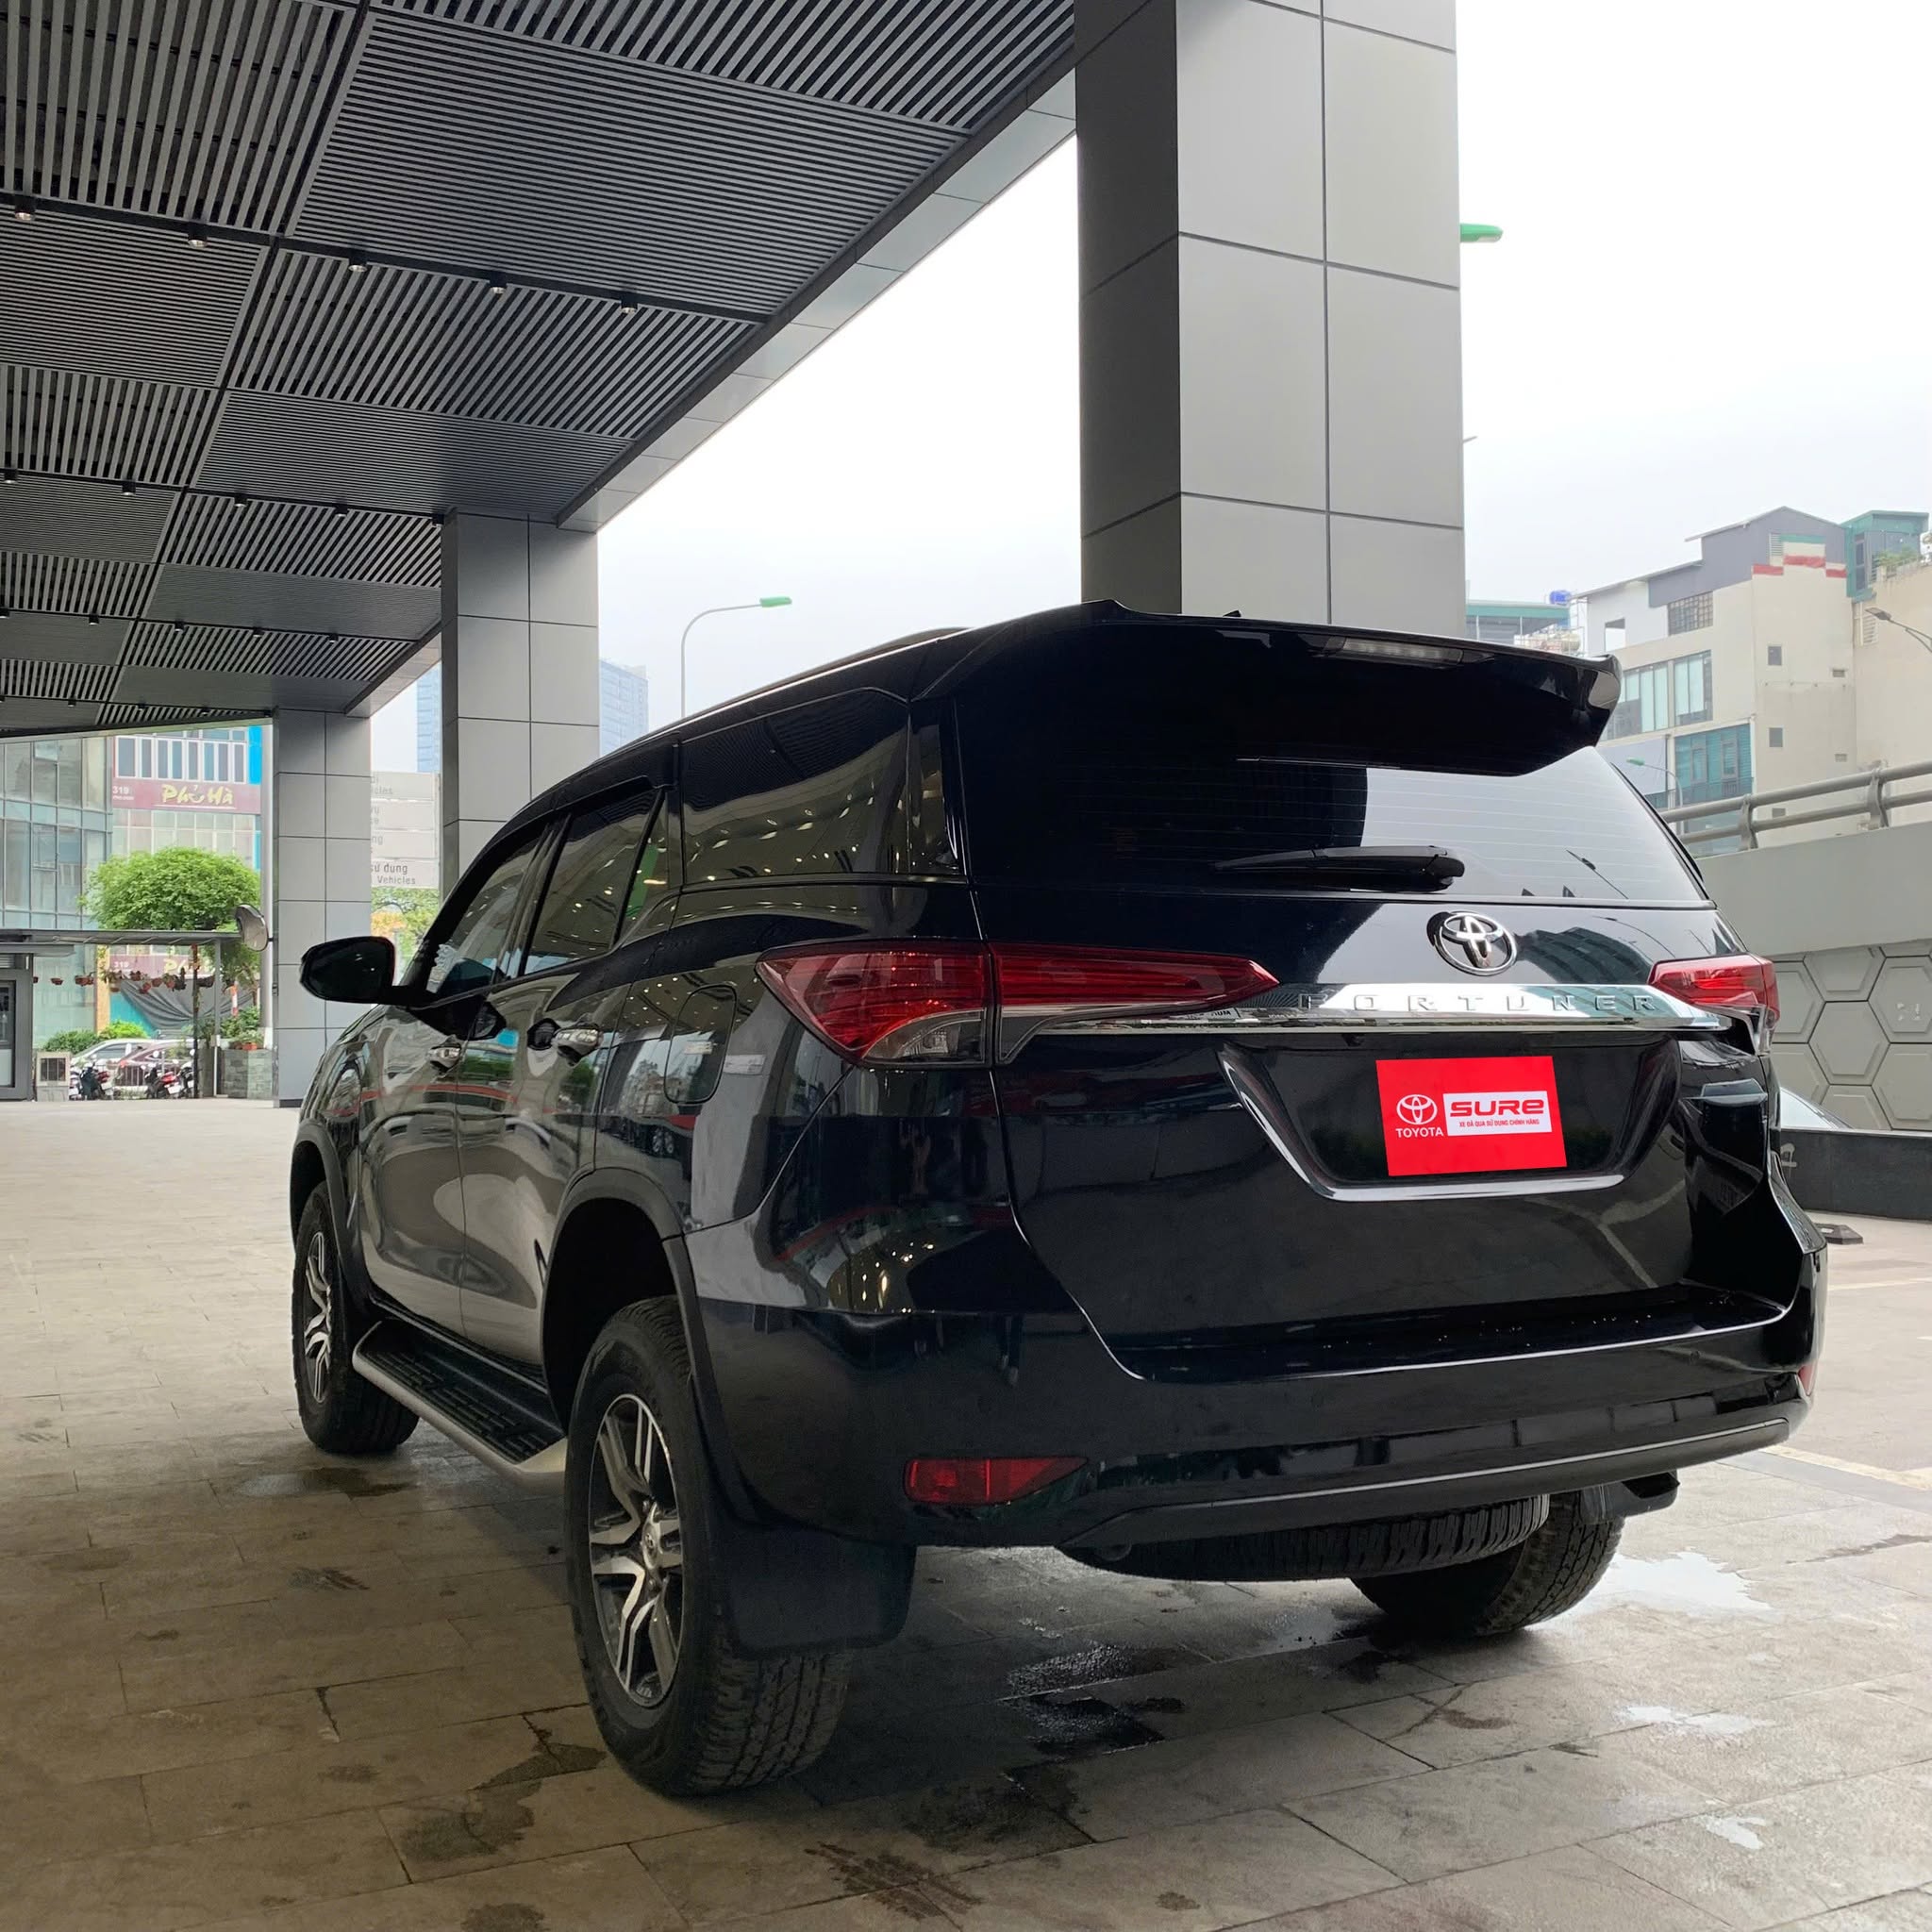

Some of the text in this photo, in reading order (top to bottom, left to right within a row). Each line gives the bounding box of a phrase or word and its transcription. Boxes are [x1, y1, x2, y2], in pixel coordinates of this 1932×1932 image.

[376, 875, 416, 885] Vehicles
[1298, 993, 1657, 1012] FORTUNER
[1395, 1126, 1444, 1139] TOYOTA
